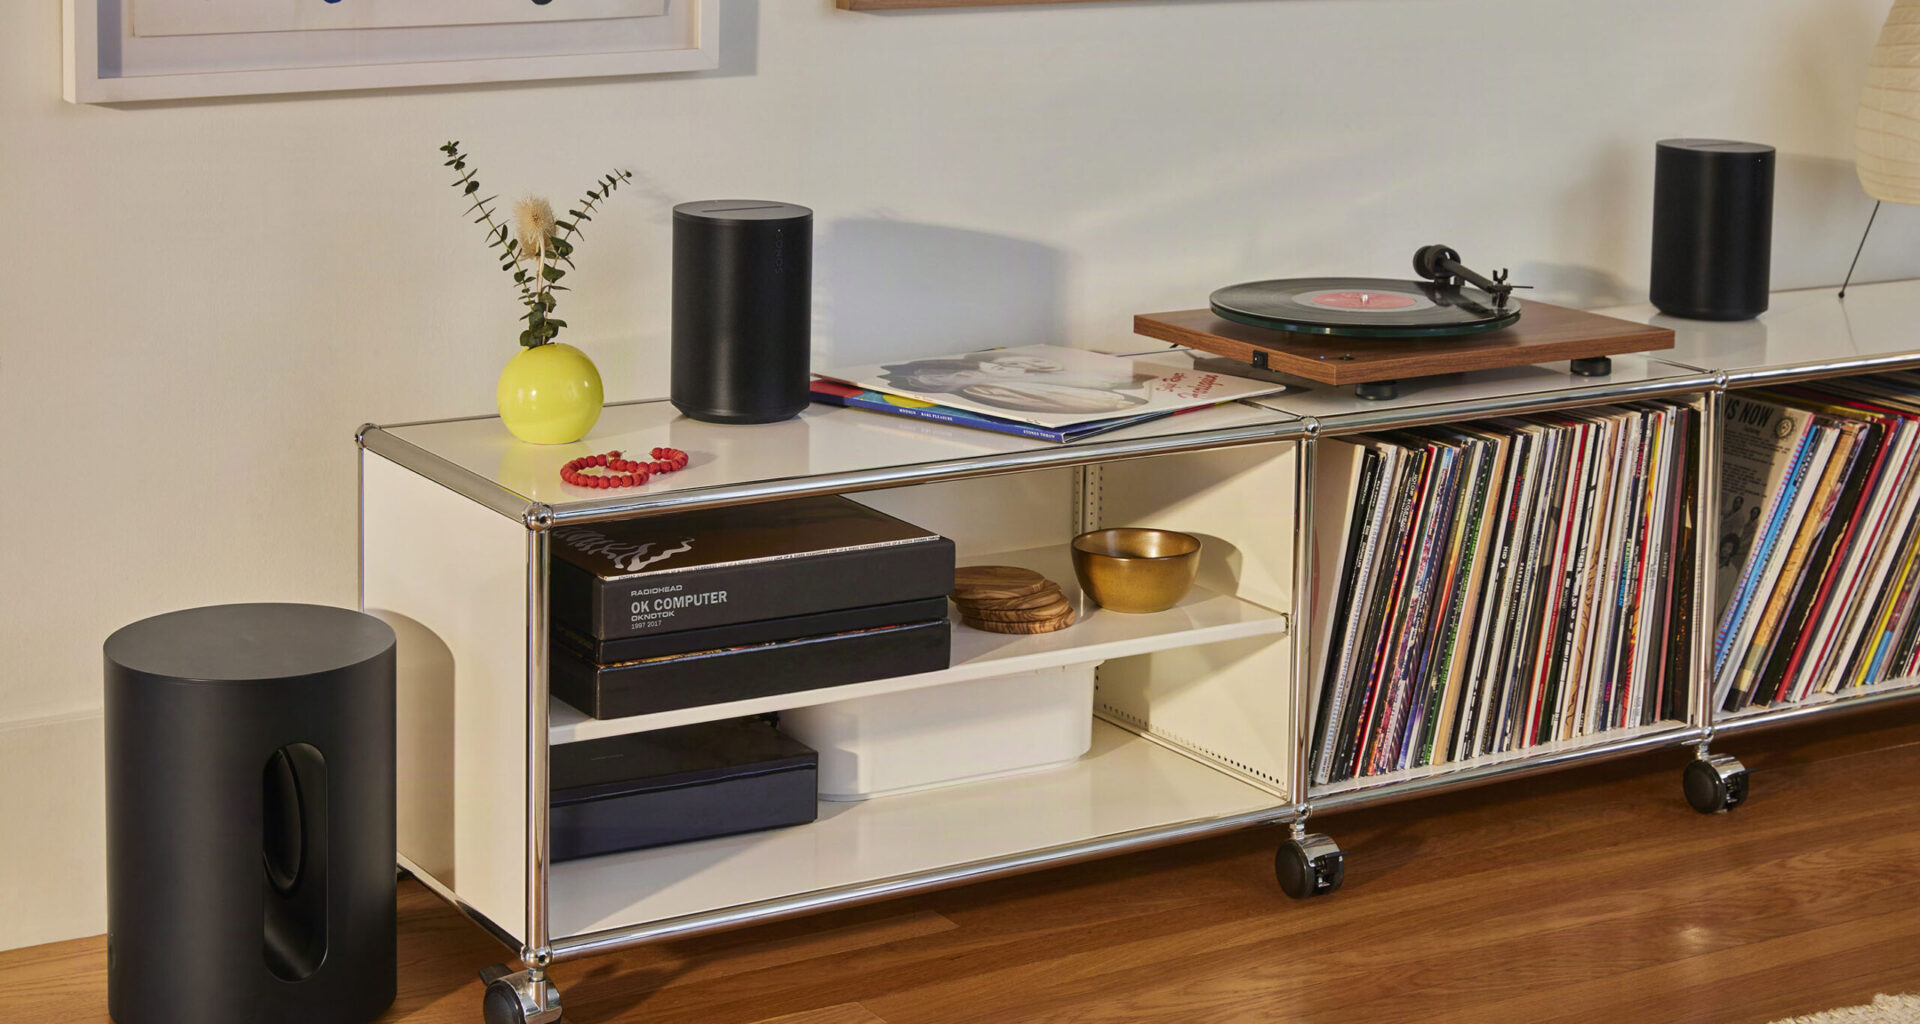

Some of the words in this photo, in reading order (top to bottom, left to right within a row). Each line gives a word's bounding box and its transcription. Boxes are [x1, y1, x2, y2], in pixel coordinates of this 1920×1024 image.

[1738, 402, 1774, 428] NOW
[1508, 475, 1522, 521] RADIOHEAD
[630, 585, 683, 597] RADIOHEAD
[630, 600, 650, 614] OK
[653, 590, 728, 611] COMPUTER
[631, 610, 675, 622] OKNOTOK
[631, 621, 646, 630] 1997
[647, 620, 662, 628] 2017
